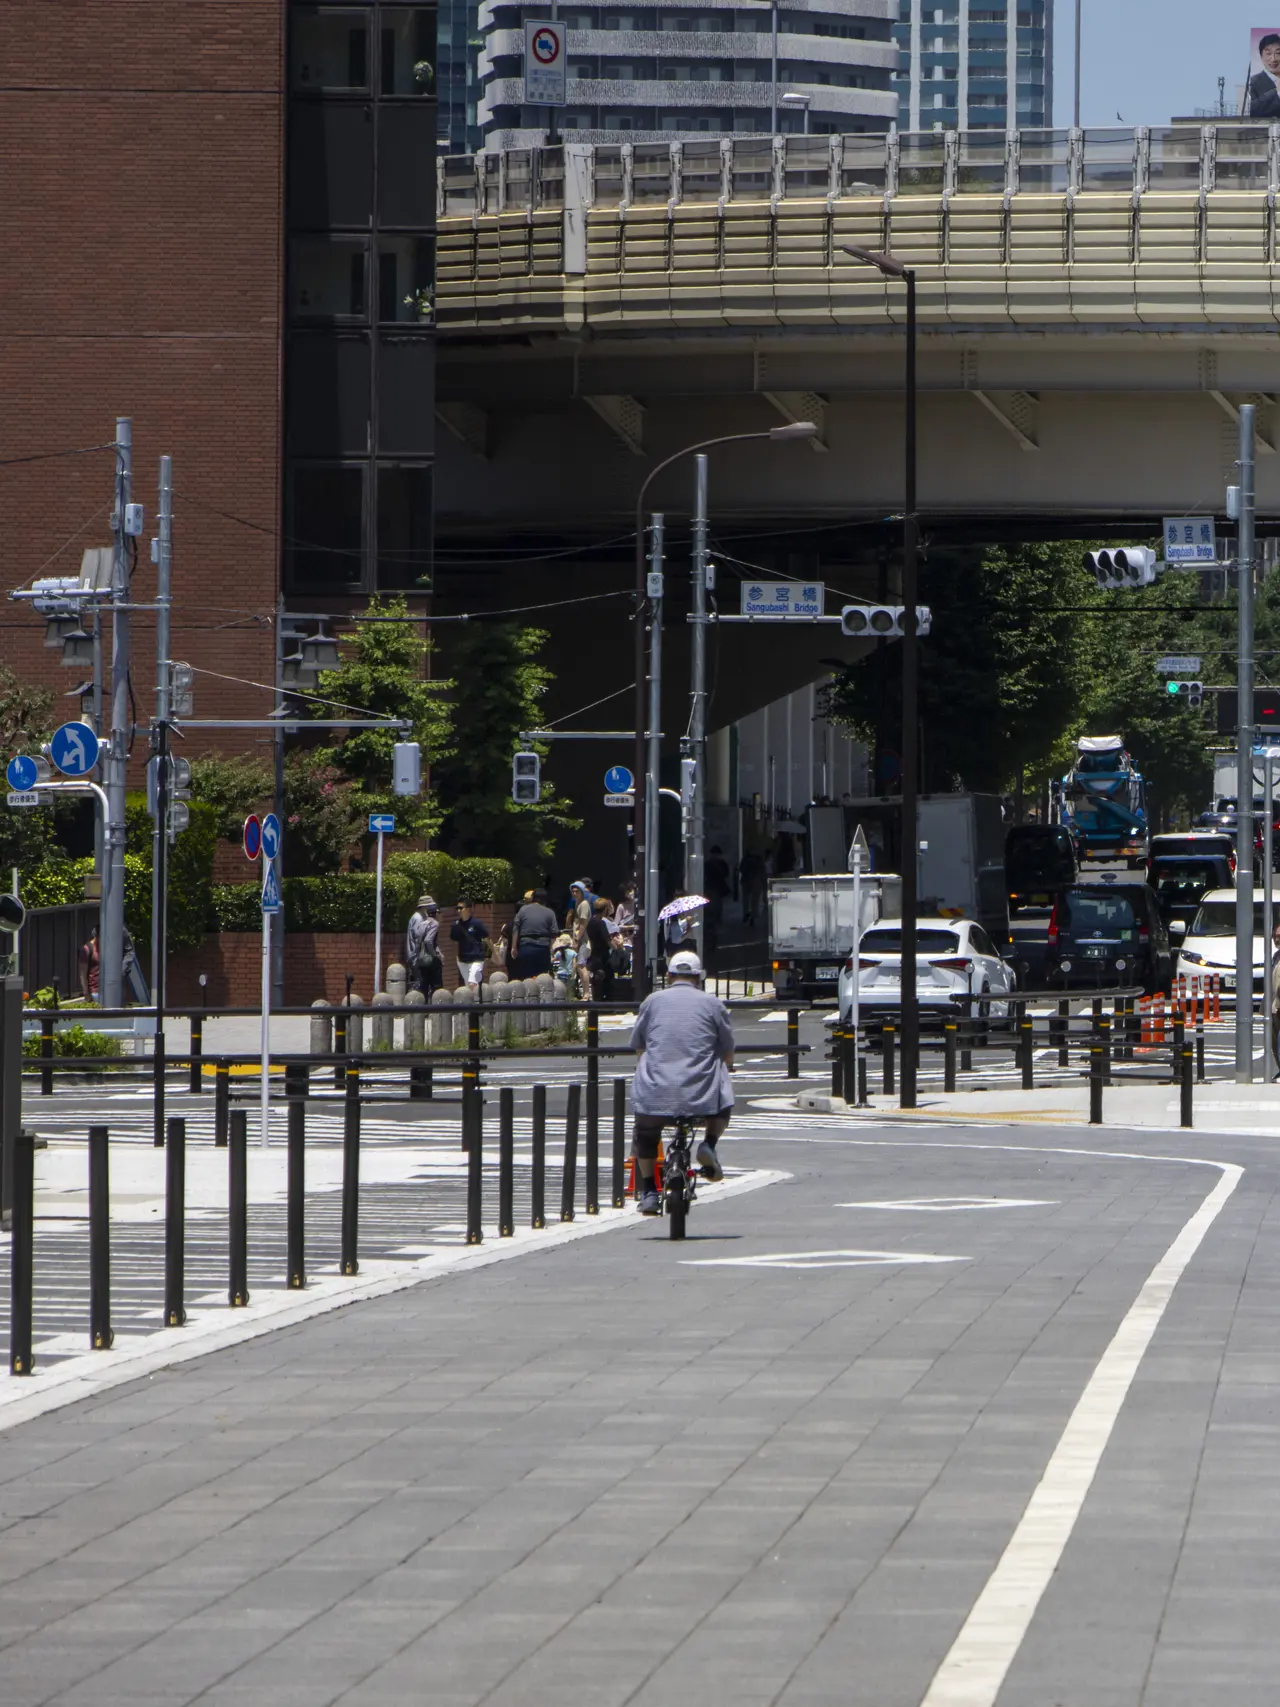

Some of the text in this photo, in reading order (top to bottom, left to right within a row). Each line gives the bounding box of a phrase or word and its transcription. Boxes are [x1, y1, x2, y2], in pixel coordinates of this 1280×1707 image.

[1168, 523, 1211, 544] 参宮橋
[1168, 545, 1213, 559] Sangubashi Bridge
[748, 585, 817, 602] 参宮橋
[746, 602, 819, 614] Sangubashi Bridge
